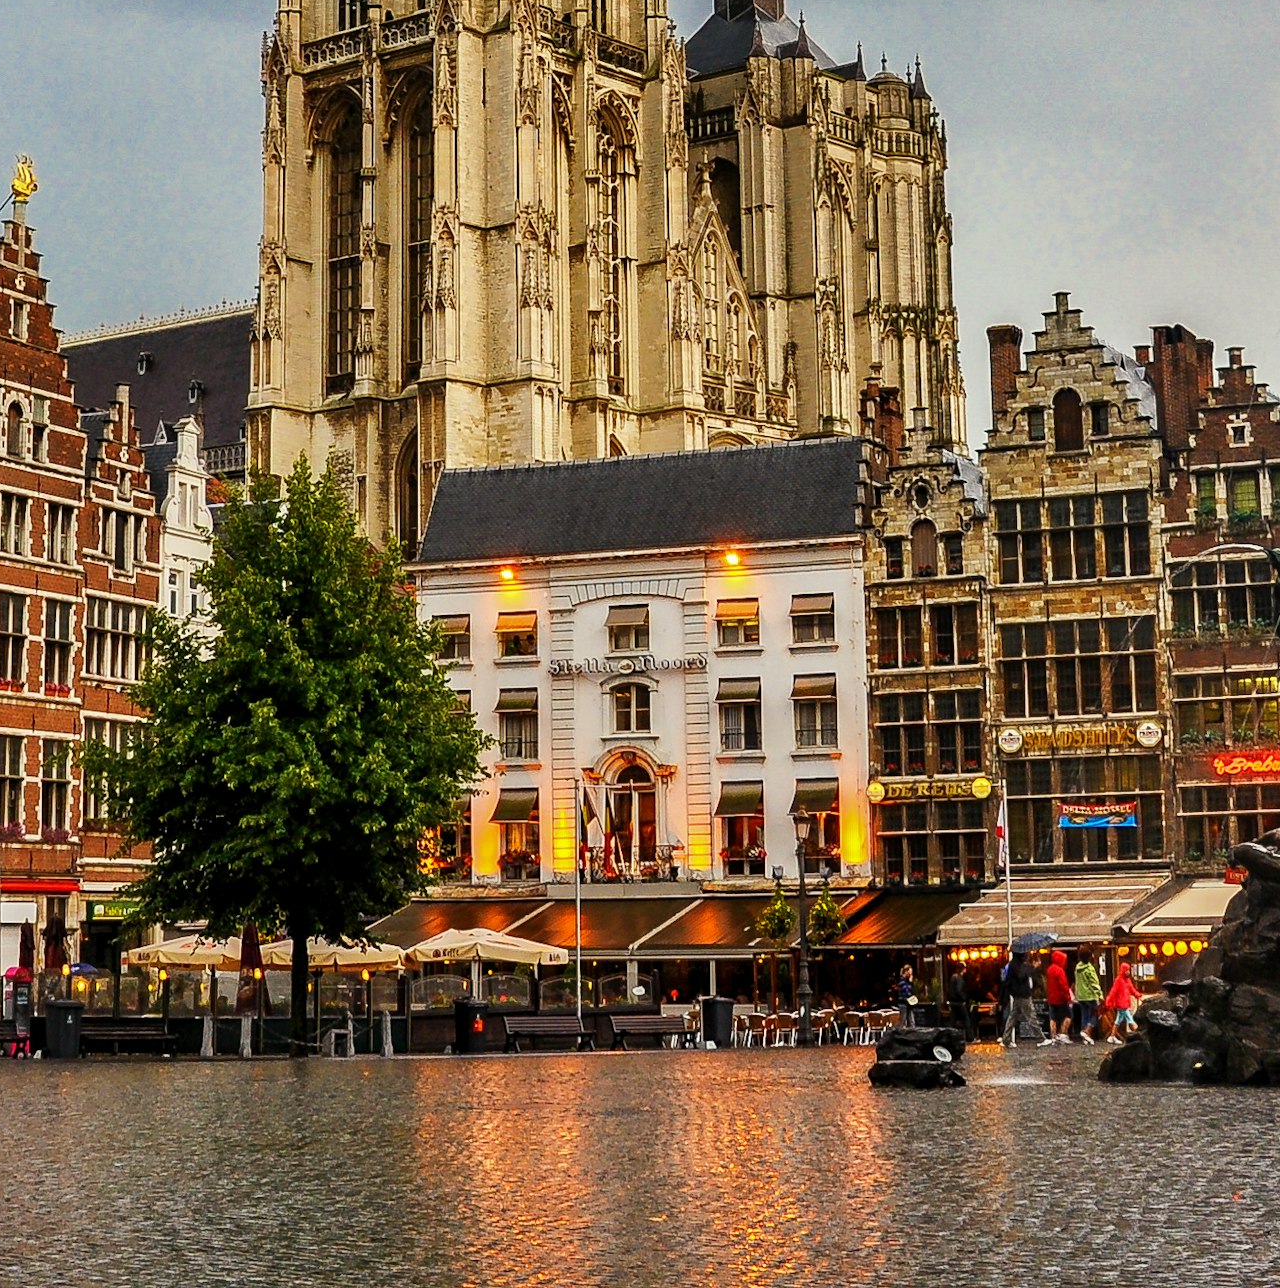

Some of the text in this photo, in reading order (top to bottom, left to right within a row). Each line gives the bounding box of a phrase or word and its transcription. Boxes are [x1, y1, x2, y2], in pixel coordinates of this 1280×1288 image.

[548, 652, 709, 675] Stella Noord
[887, 784, 913, 799] DE
[1062, 805, 1092, 815] DELTA
